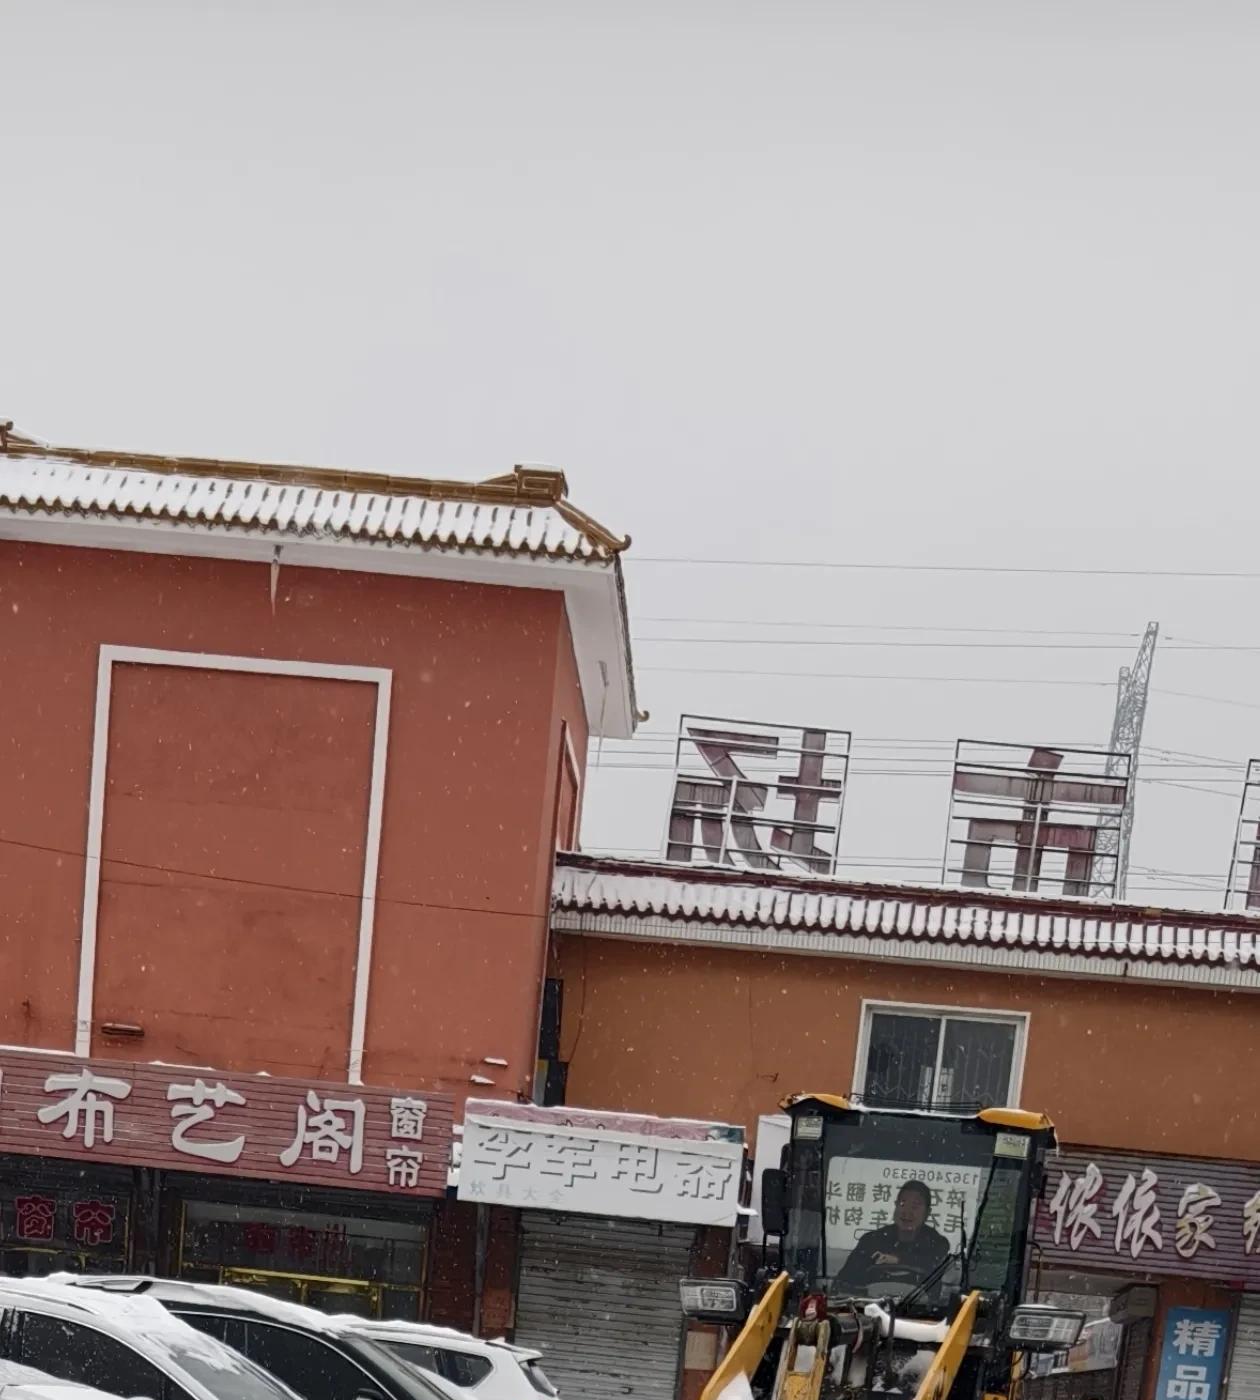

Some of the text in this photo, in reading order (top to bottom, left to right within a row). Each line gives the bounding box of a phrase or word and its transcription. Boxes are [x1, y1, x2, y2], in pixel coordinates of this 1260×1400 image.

[0, 1068, 367, 1175] 布艺阁
[385, 1096, 428, 1188] 窗帘
[1048, 1162, 1260, 1259] 侬依家
